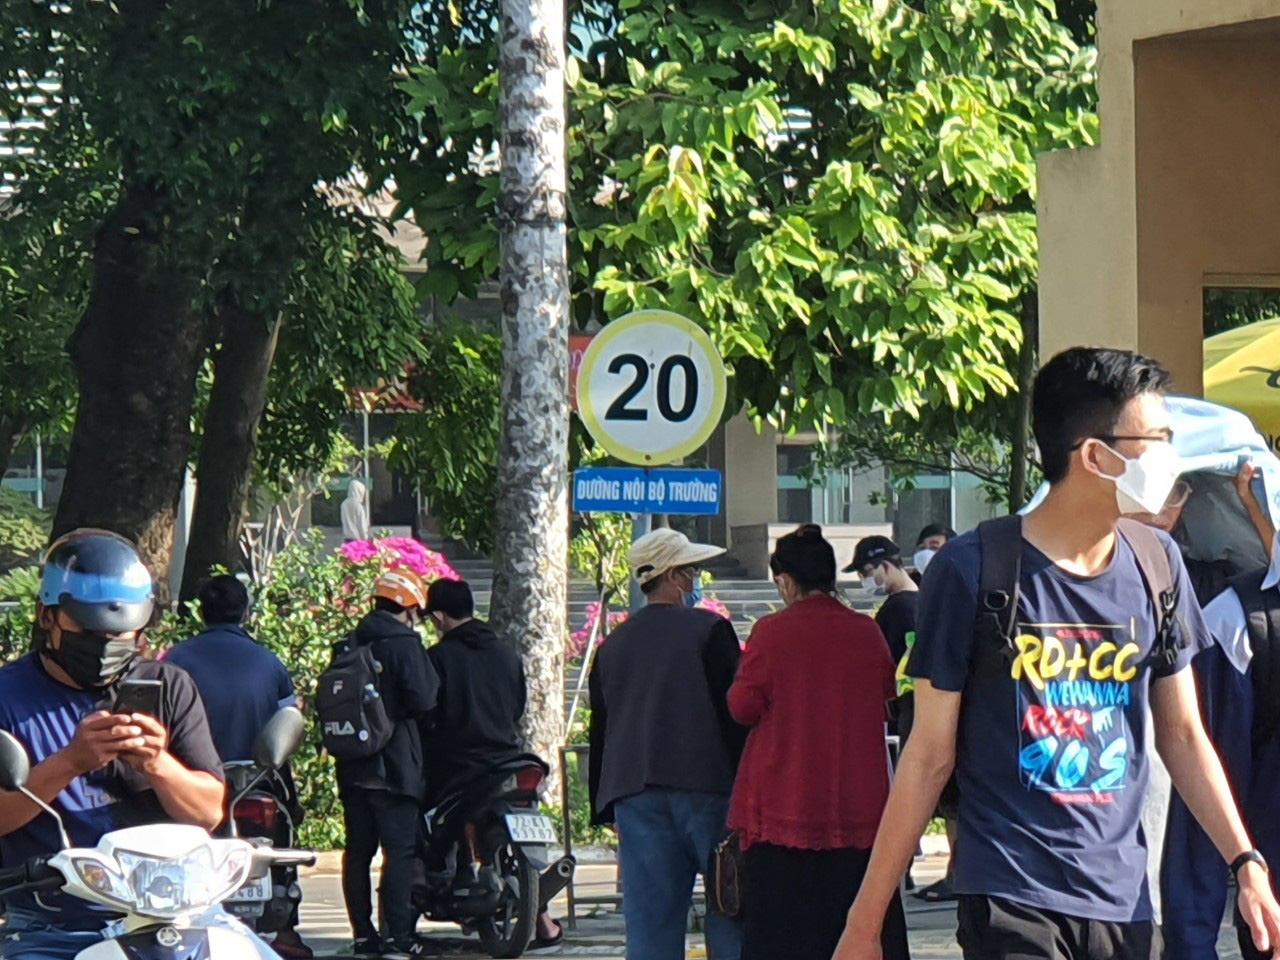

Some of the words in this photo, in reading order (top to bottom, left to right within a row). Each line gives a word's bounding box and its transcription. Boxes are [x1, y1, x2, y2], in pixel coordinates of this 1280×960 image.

[604, 354, 699, 422] 20
[623, 476, 645, 505] NỘI
[648, 478, 665, 506] BỘ
[669, 478, 718, 502] TRƯỜNG
[1011, 634, 1140, 690] RD+CC
[324, 720, 356, 736] FILA
